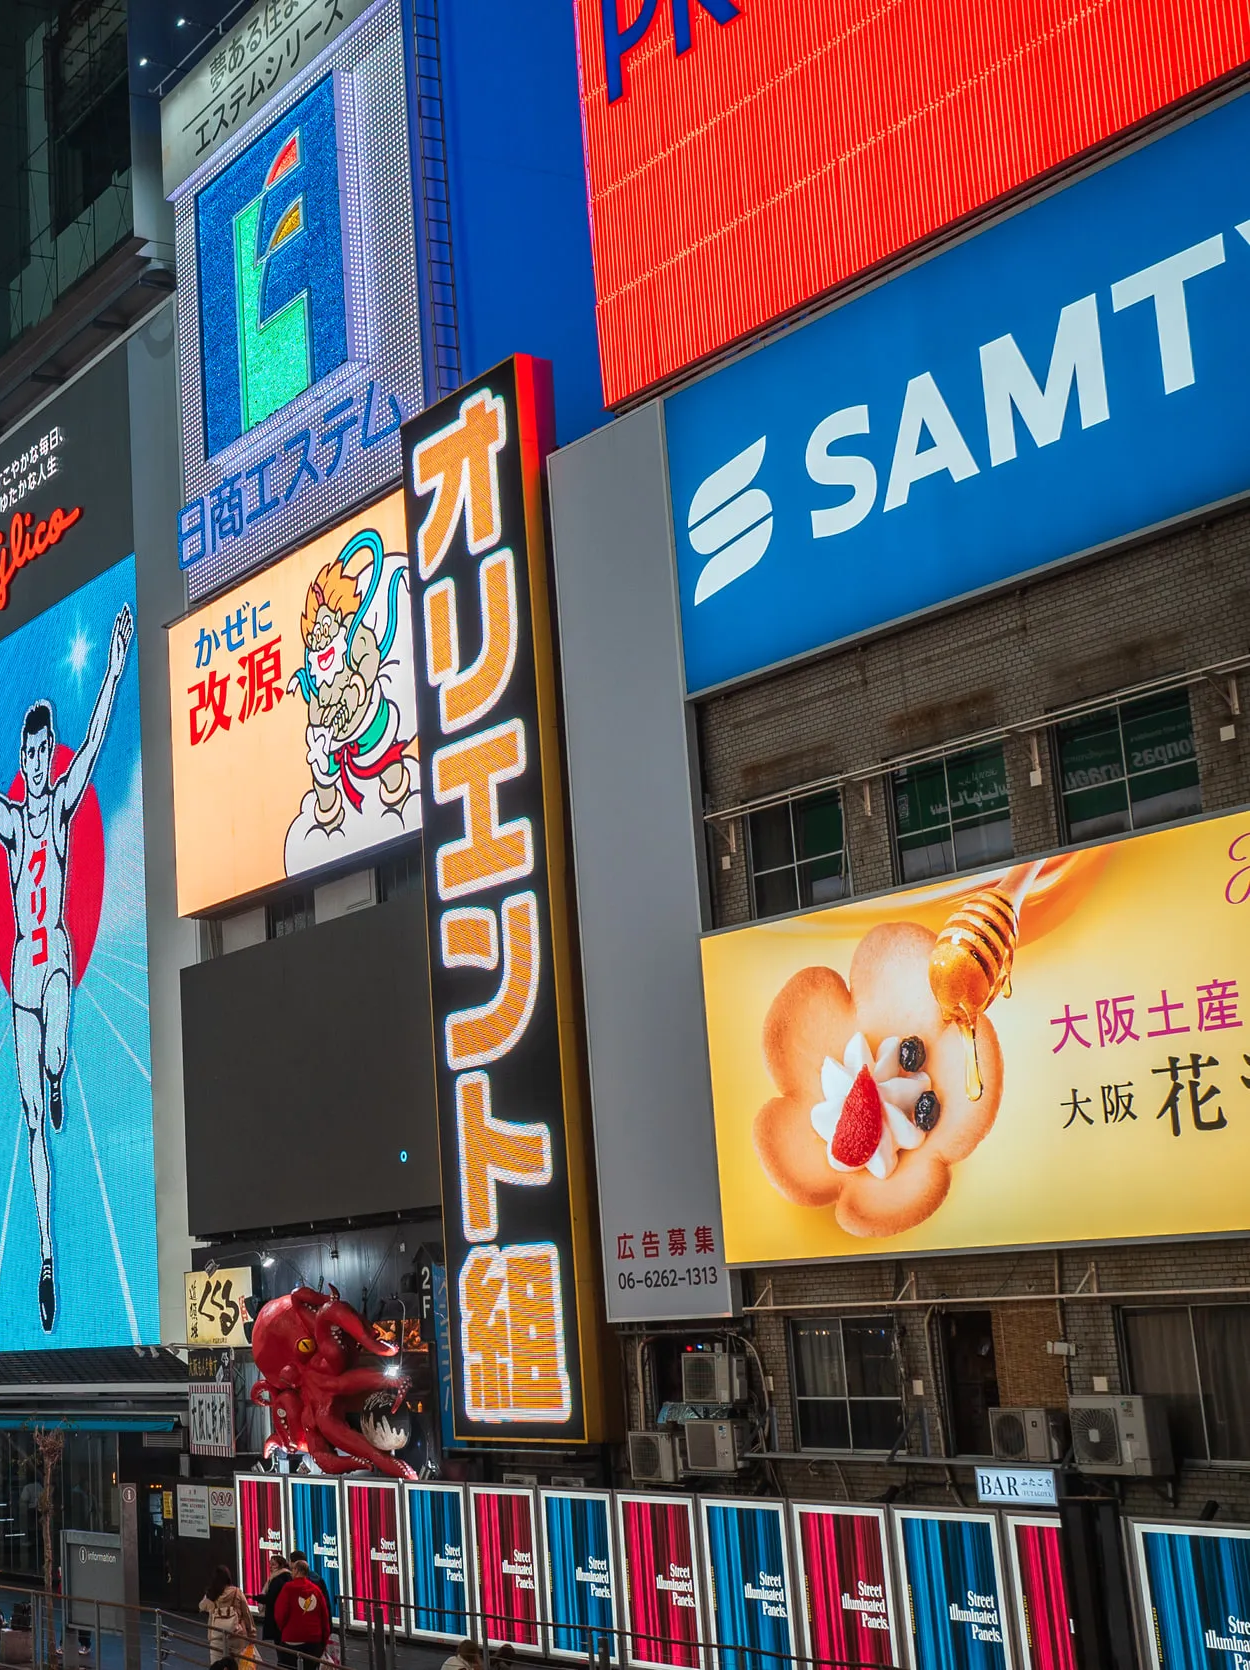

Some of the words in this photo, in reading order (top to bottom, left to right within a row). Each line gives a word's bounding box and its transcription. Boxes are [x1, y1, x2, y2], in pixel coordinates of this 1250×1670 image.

[0, 456, 58, 512] ゆたかな人生
[178, 380, 401, 571] 日商エステム
[195, 600, 273, 668] かぜに
[187, 634, 286, 746] 改源
[28, 844, 49, 966] グリコ
[1050, 978, 1244, 1055] 大阪土産
[1060, 1081, 1138, 1129] 大阪
[616, 1224, 716, 1261] 広告募集
[617, 1265, 718, 1291] 06-6262-1313
[421, 1266, 431, 1319] 2F
[979, 1475, 1020, 1497] BAR
[1021, 1478, 1052, 1487] ふたごや
[514, 1549, 530, 1562] Street
[588, 1556, 607, 1570] Street
[670, 1563, 690, 1578] Street
[759, 1571, 781, 1587] Street
[590, 1583, 612, 1598] Panels.
[672, 1592, 696, 1607] Panels.
[858, 1580, 882, 1597] Street
[967, 1590, 994, 1609] Street
[762, 1601, 787, 1618] Panels.
[861, 1612, 889, 1630] Panels.
[972, 1624, 1002, 1643] Panels.
[1152, 1607, 1164, 1663] DOTONBORI
